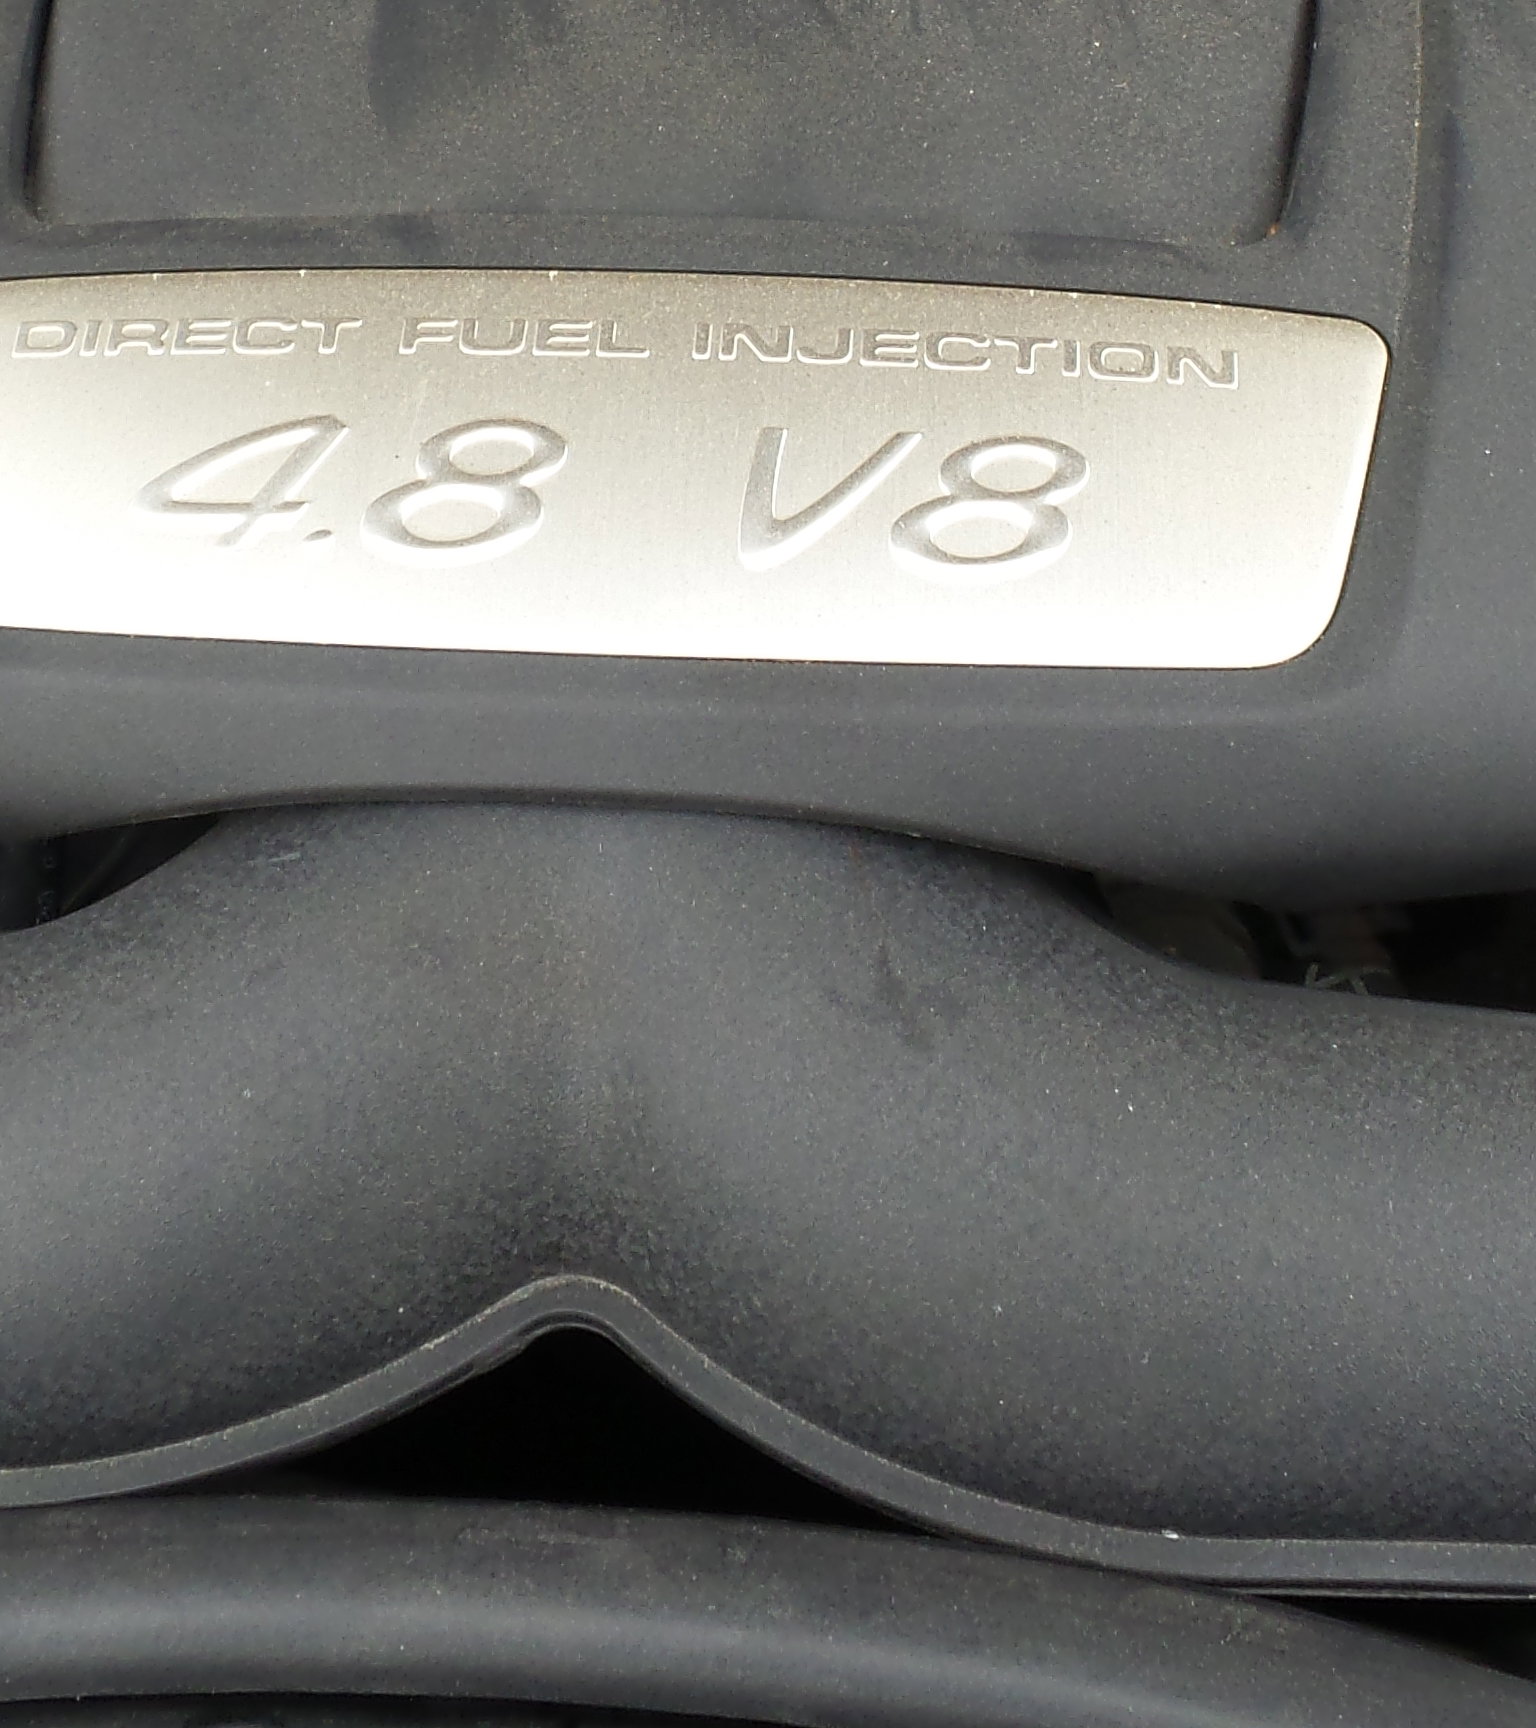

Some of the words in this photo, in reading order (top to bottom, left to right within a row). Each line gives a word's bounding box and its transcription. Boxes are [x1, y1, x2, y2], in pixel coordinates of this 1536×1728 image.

[11, 316, 363, 359] DIRECT
[398, 316, 651, 360] FUEL
[691, 321, 1240, 391] INJECTION
[133, 414, 568, 568] 4.8
[737, 426, 1092, 571] V8
